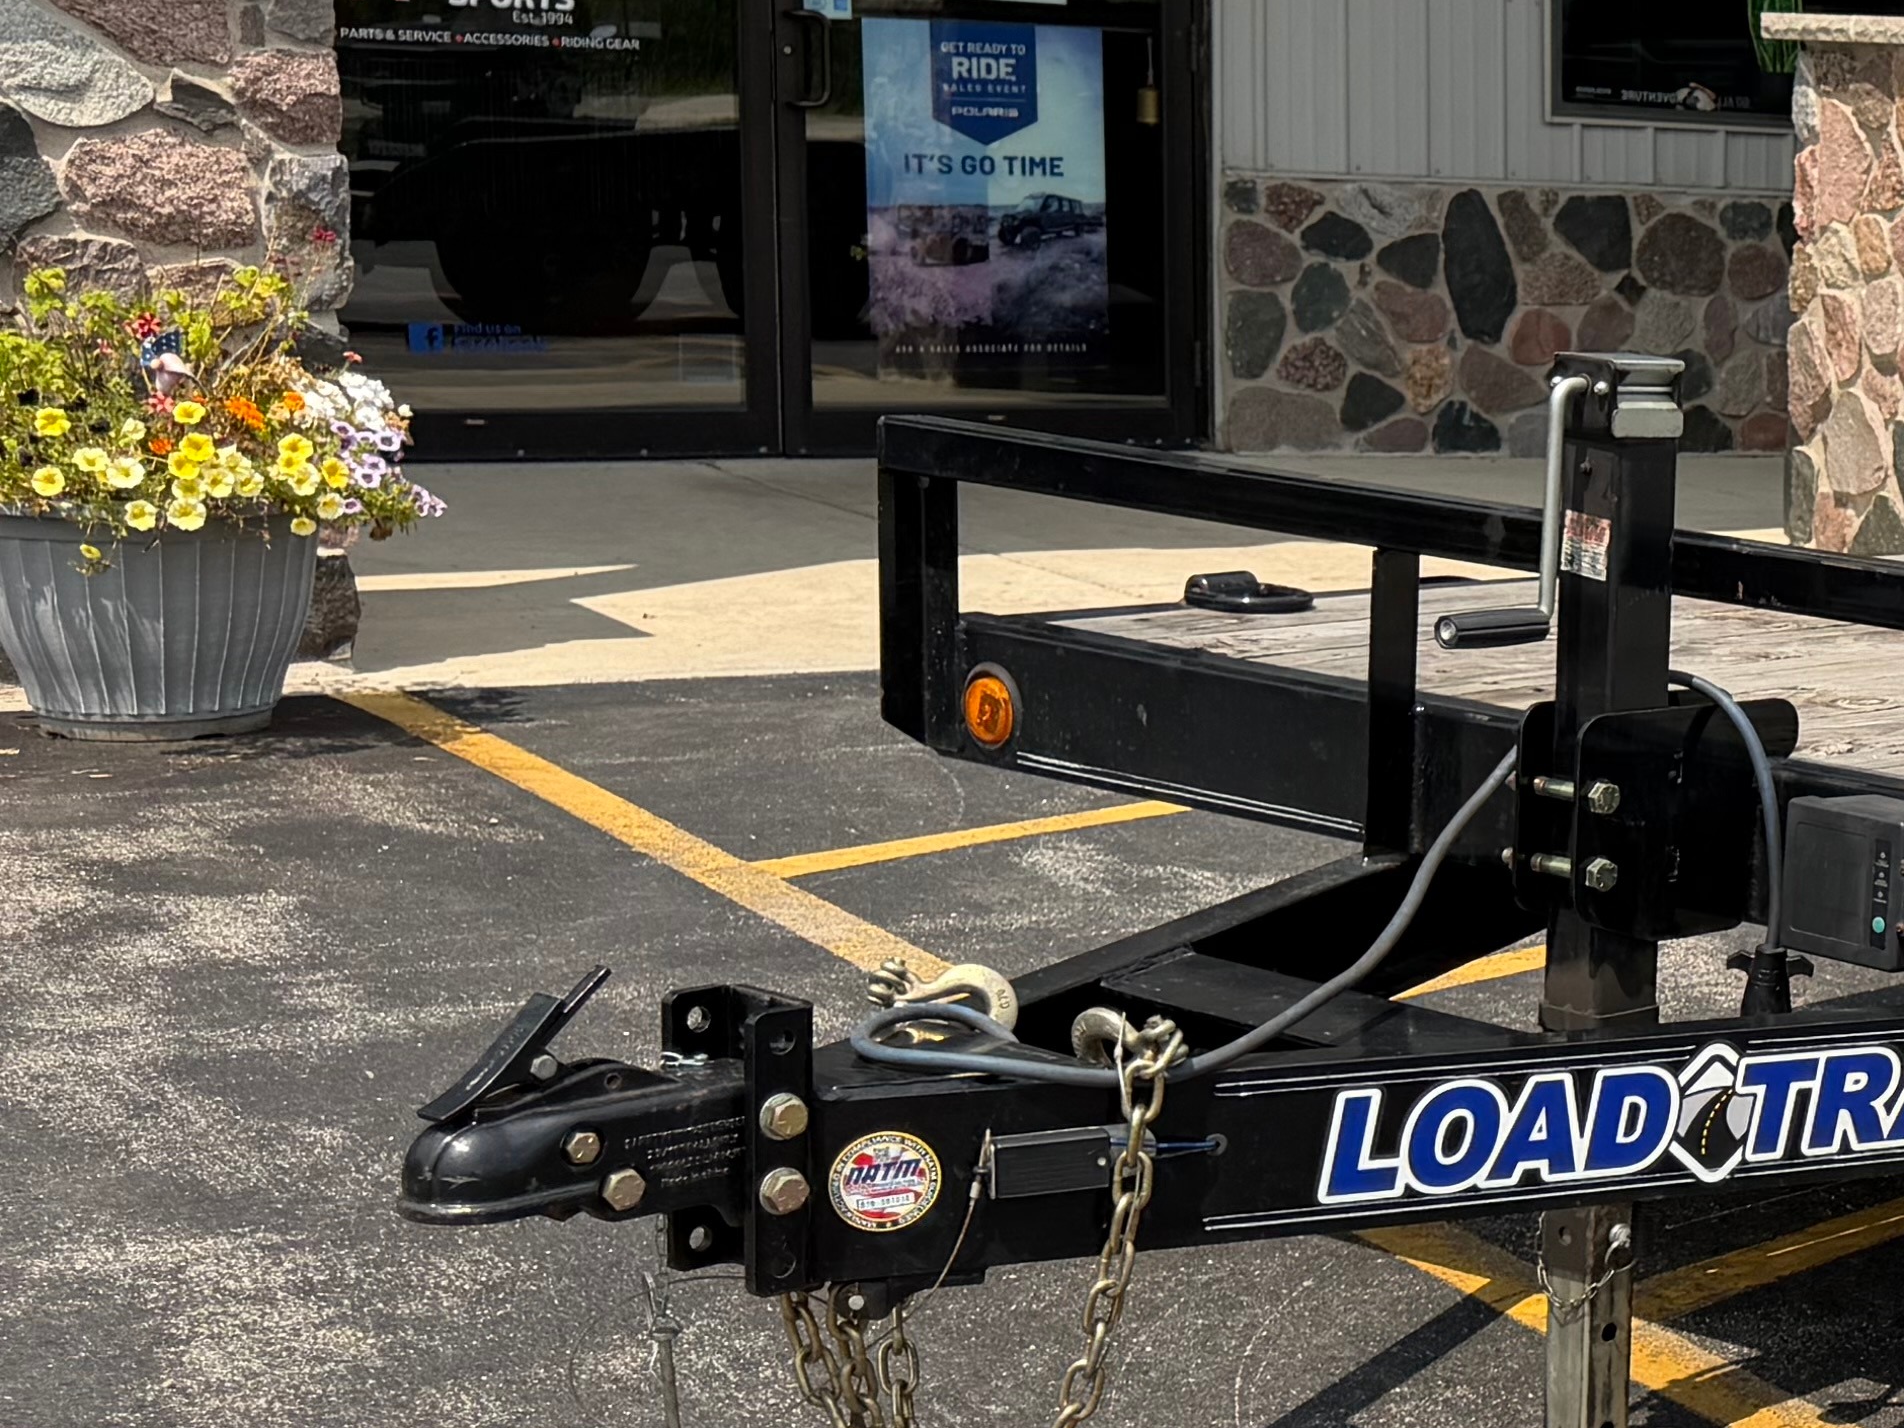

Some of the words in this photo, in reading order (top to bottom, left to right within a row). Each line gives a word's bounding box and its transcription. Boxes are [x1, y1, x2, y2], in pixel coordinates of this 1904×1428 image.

[340, 27, 383, 40] PARTS
[385, 29, 395, 40] &
[398, 29, 451, 43] SERVICE
[464, 33, 549, 47] ACCESSORIES
[560, 36, 604, 48] RIDING
[606, 37, 640, 50] GEAR
[941, 41, 964, 53] GET
[967, 42, 1007, 55] READY
[1010, 43, 1026, 55] TO
[951, 56, 1017, 81] RIDE
[951, 106, 1019, 118] POLARIS
[904, 153, 953, 175] IT'S
[961, 155, 996, 176] GO
[1003, 156, 1065, 177] TIME
[1318, 1064, 1679, 1204] LOAD
